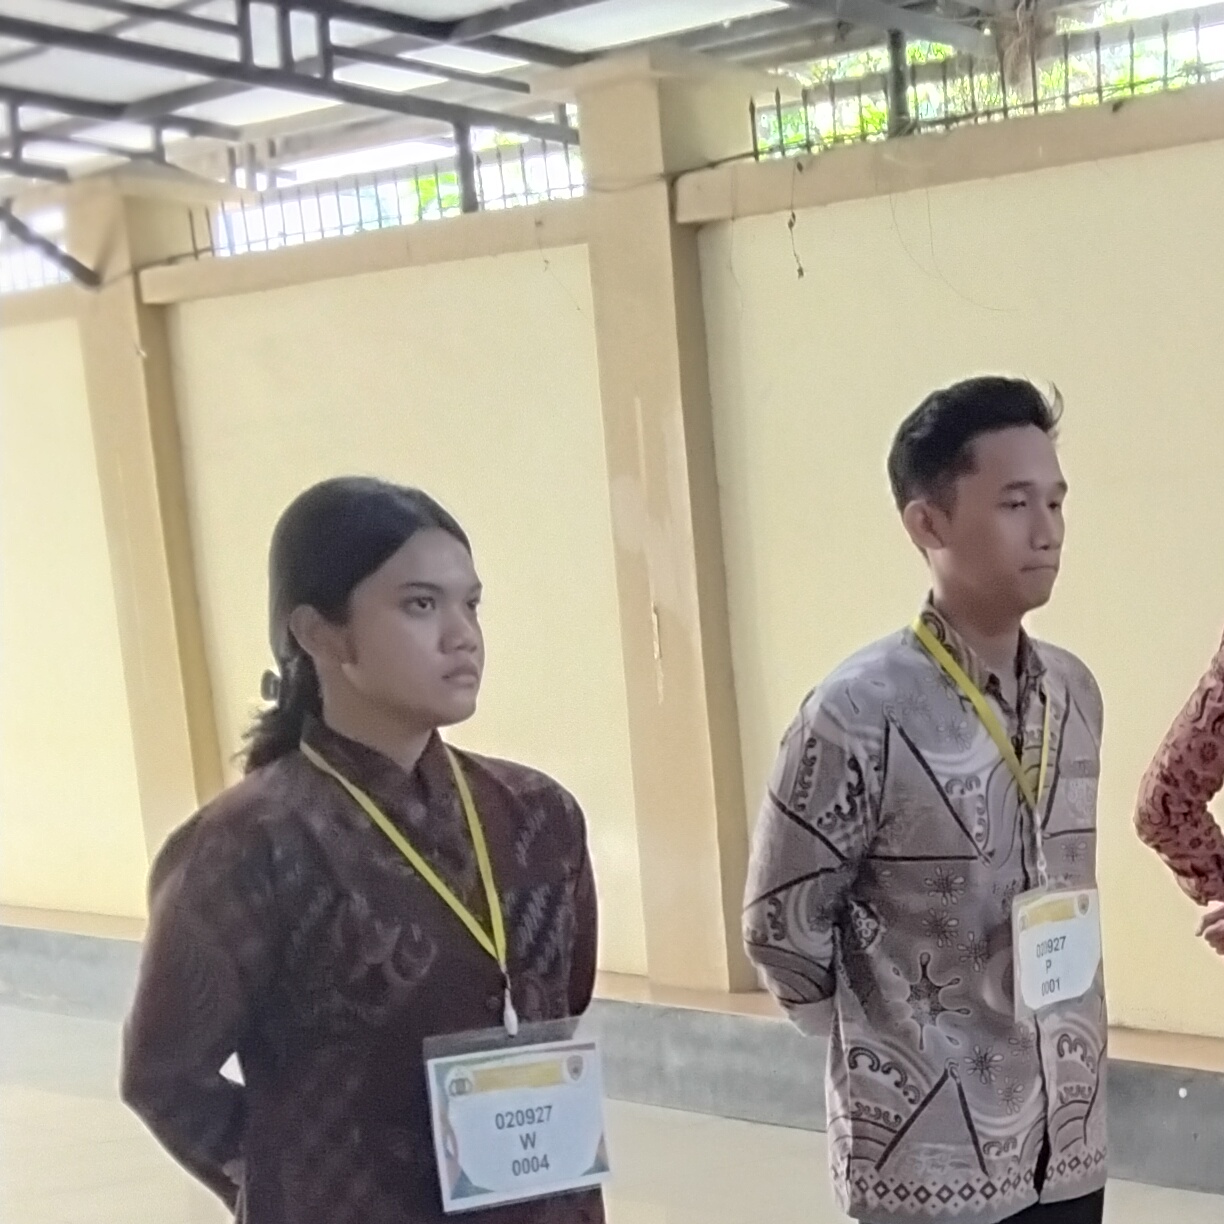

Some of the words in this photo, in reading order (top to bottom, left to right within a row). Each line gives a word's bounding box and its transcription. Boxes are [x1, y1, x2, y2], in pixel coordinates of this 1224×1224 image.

[1045, 959, 1052, 974] P
[495, 1105, 552, 1130] 020927
[519, 1131, 537, 1150] W
[511, 1154, 549, 1176] 0004
